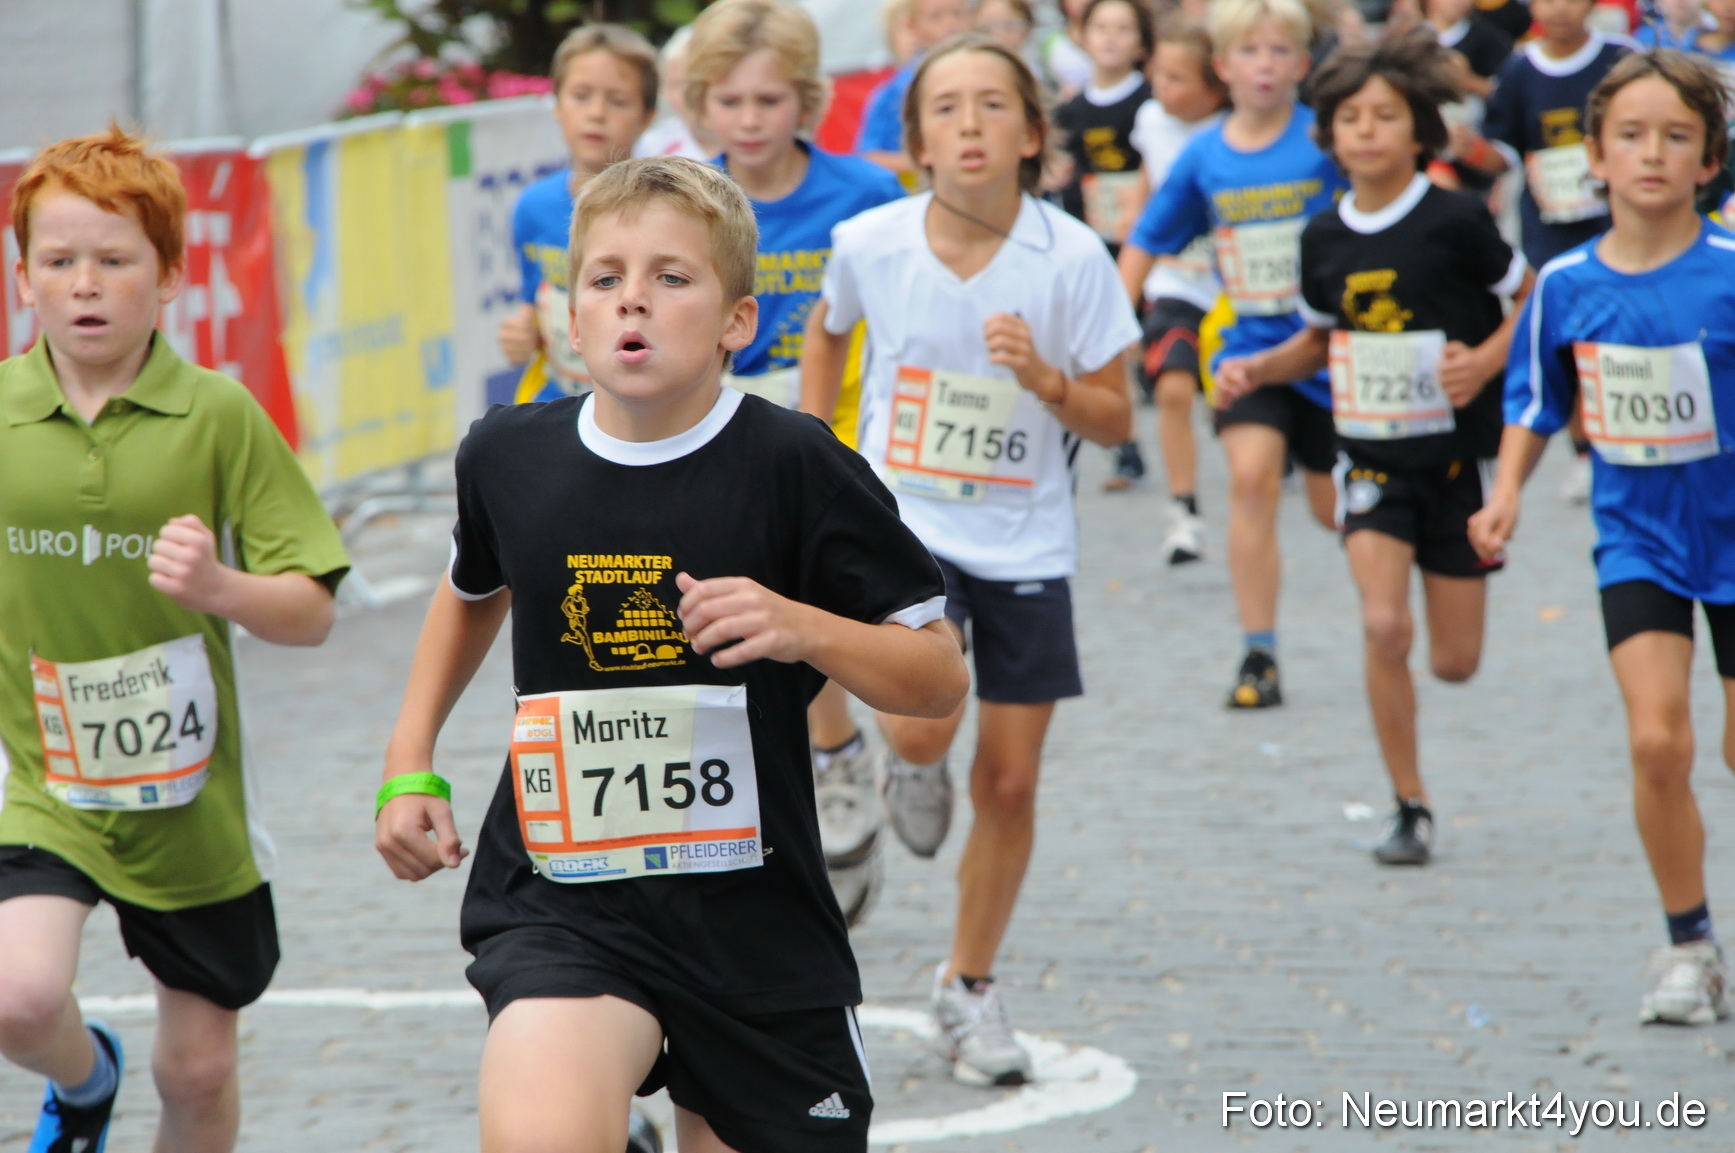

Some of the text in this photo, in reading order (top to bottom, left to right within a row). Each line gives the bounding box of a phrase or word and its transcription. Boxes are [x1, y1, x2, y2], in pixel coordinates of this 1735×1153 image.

[1359, 373, 1436, 402] 7226
[1609, 391, 1696, 423] 7030
[935, 421, 1028, 463] 7156
[7, 526, 77, 557] EURO
[567, 555, 673, 569] NEUMARKTER
[575, 570, 662, 584] STADTLAUF
[592, 630, 691, 644] BAMBINILAU
[68, 657, 174, 703] Frederik
[82, 701, 206, 760] 7024
[572, 710, 669, 745] Moritz
[524, 768, 552, 793] K6
[582, 759, 734, 817] 7158
[549, 856, 609, 872] BOCK
[670, 840, 757, 859] PFLEIDERER
